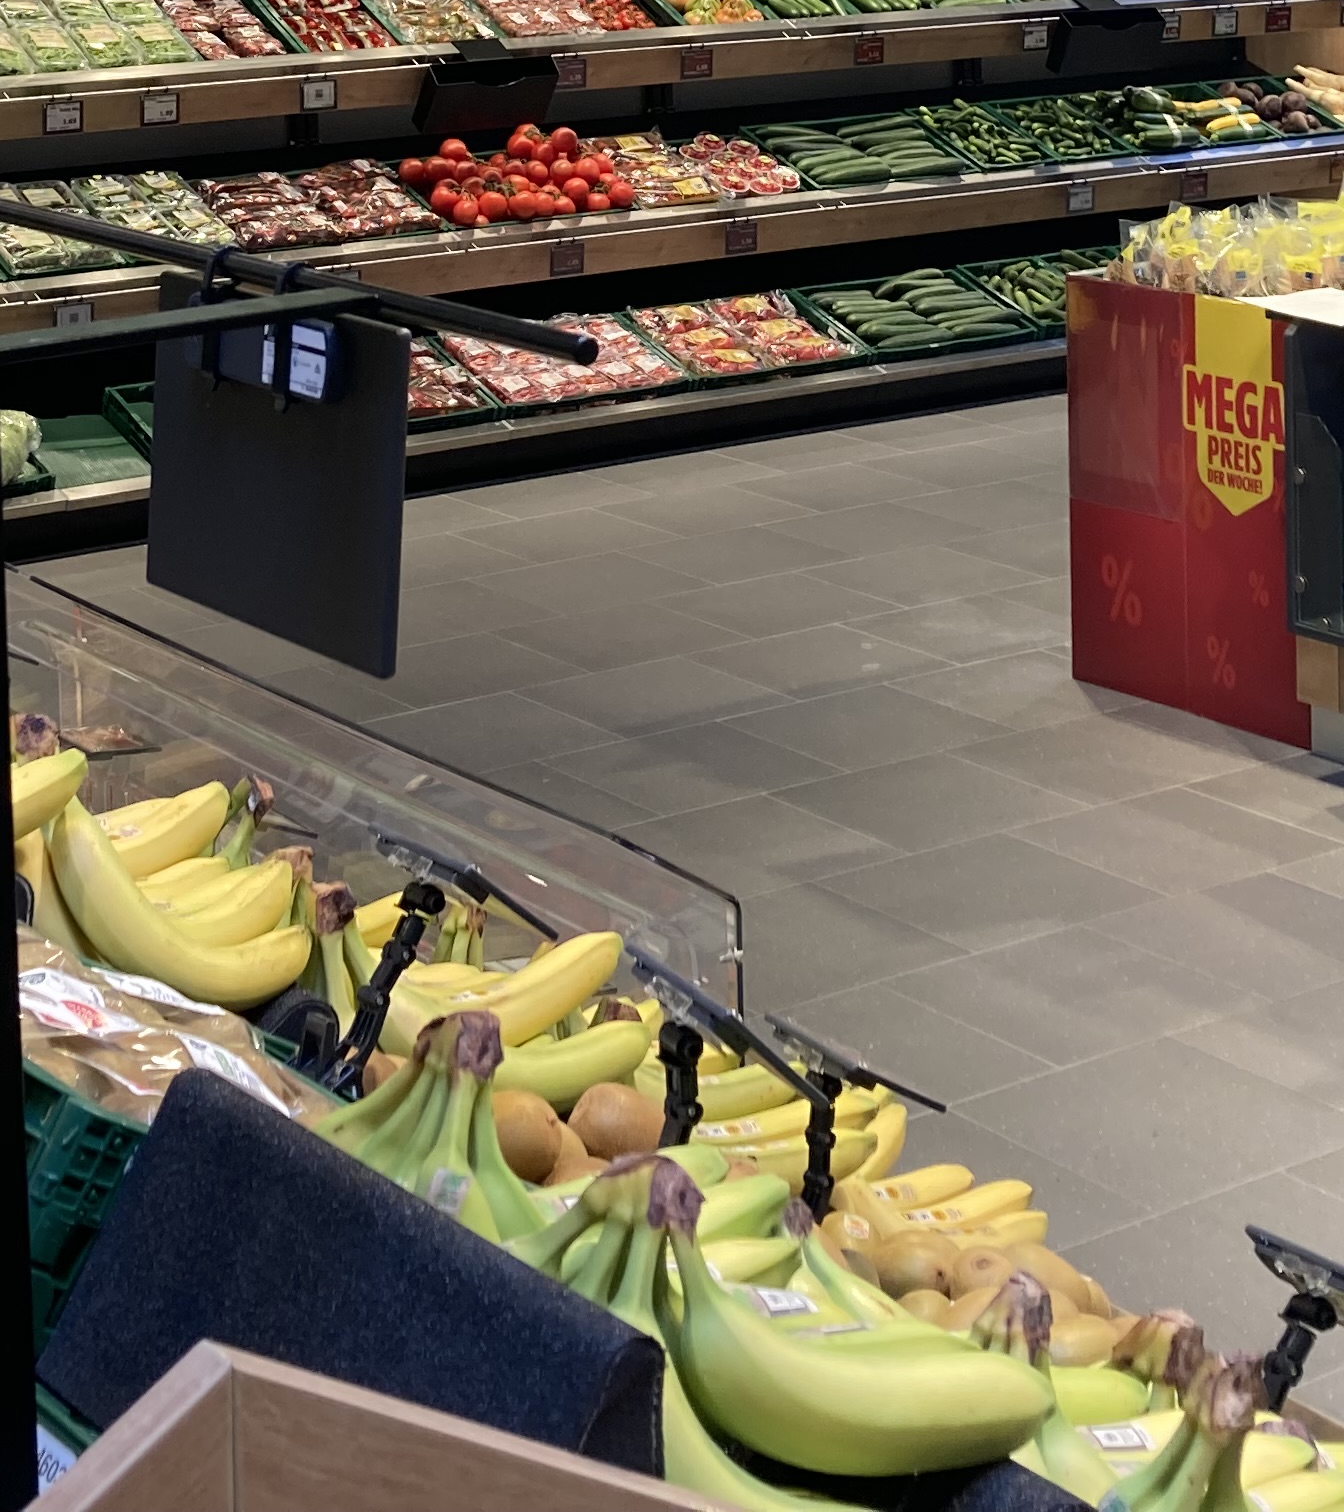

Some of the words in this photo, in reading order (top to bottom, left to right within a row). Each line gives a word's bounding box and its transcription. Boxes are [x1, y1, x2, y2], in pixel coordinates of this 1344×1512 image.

[1186, 369, 1286, 446] MEGA
[1207, 434, 1263, 476] PREIS
[1207, 467, 1225, 487] DER
[1227, 471, 1264, 496] WOCHE!
[1101, 553, 1143, 627] %
[1207, 634, 1237, 690] %
